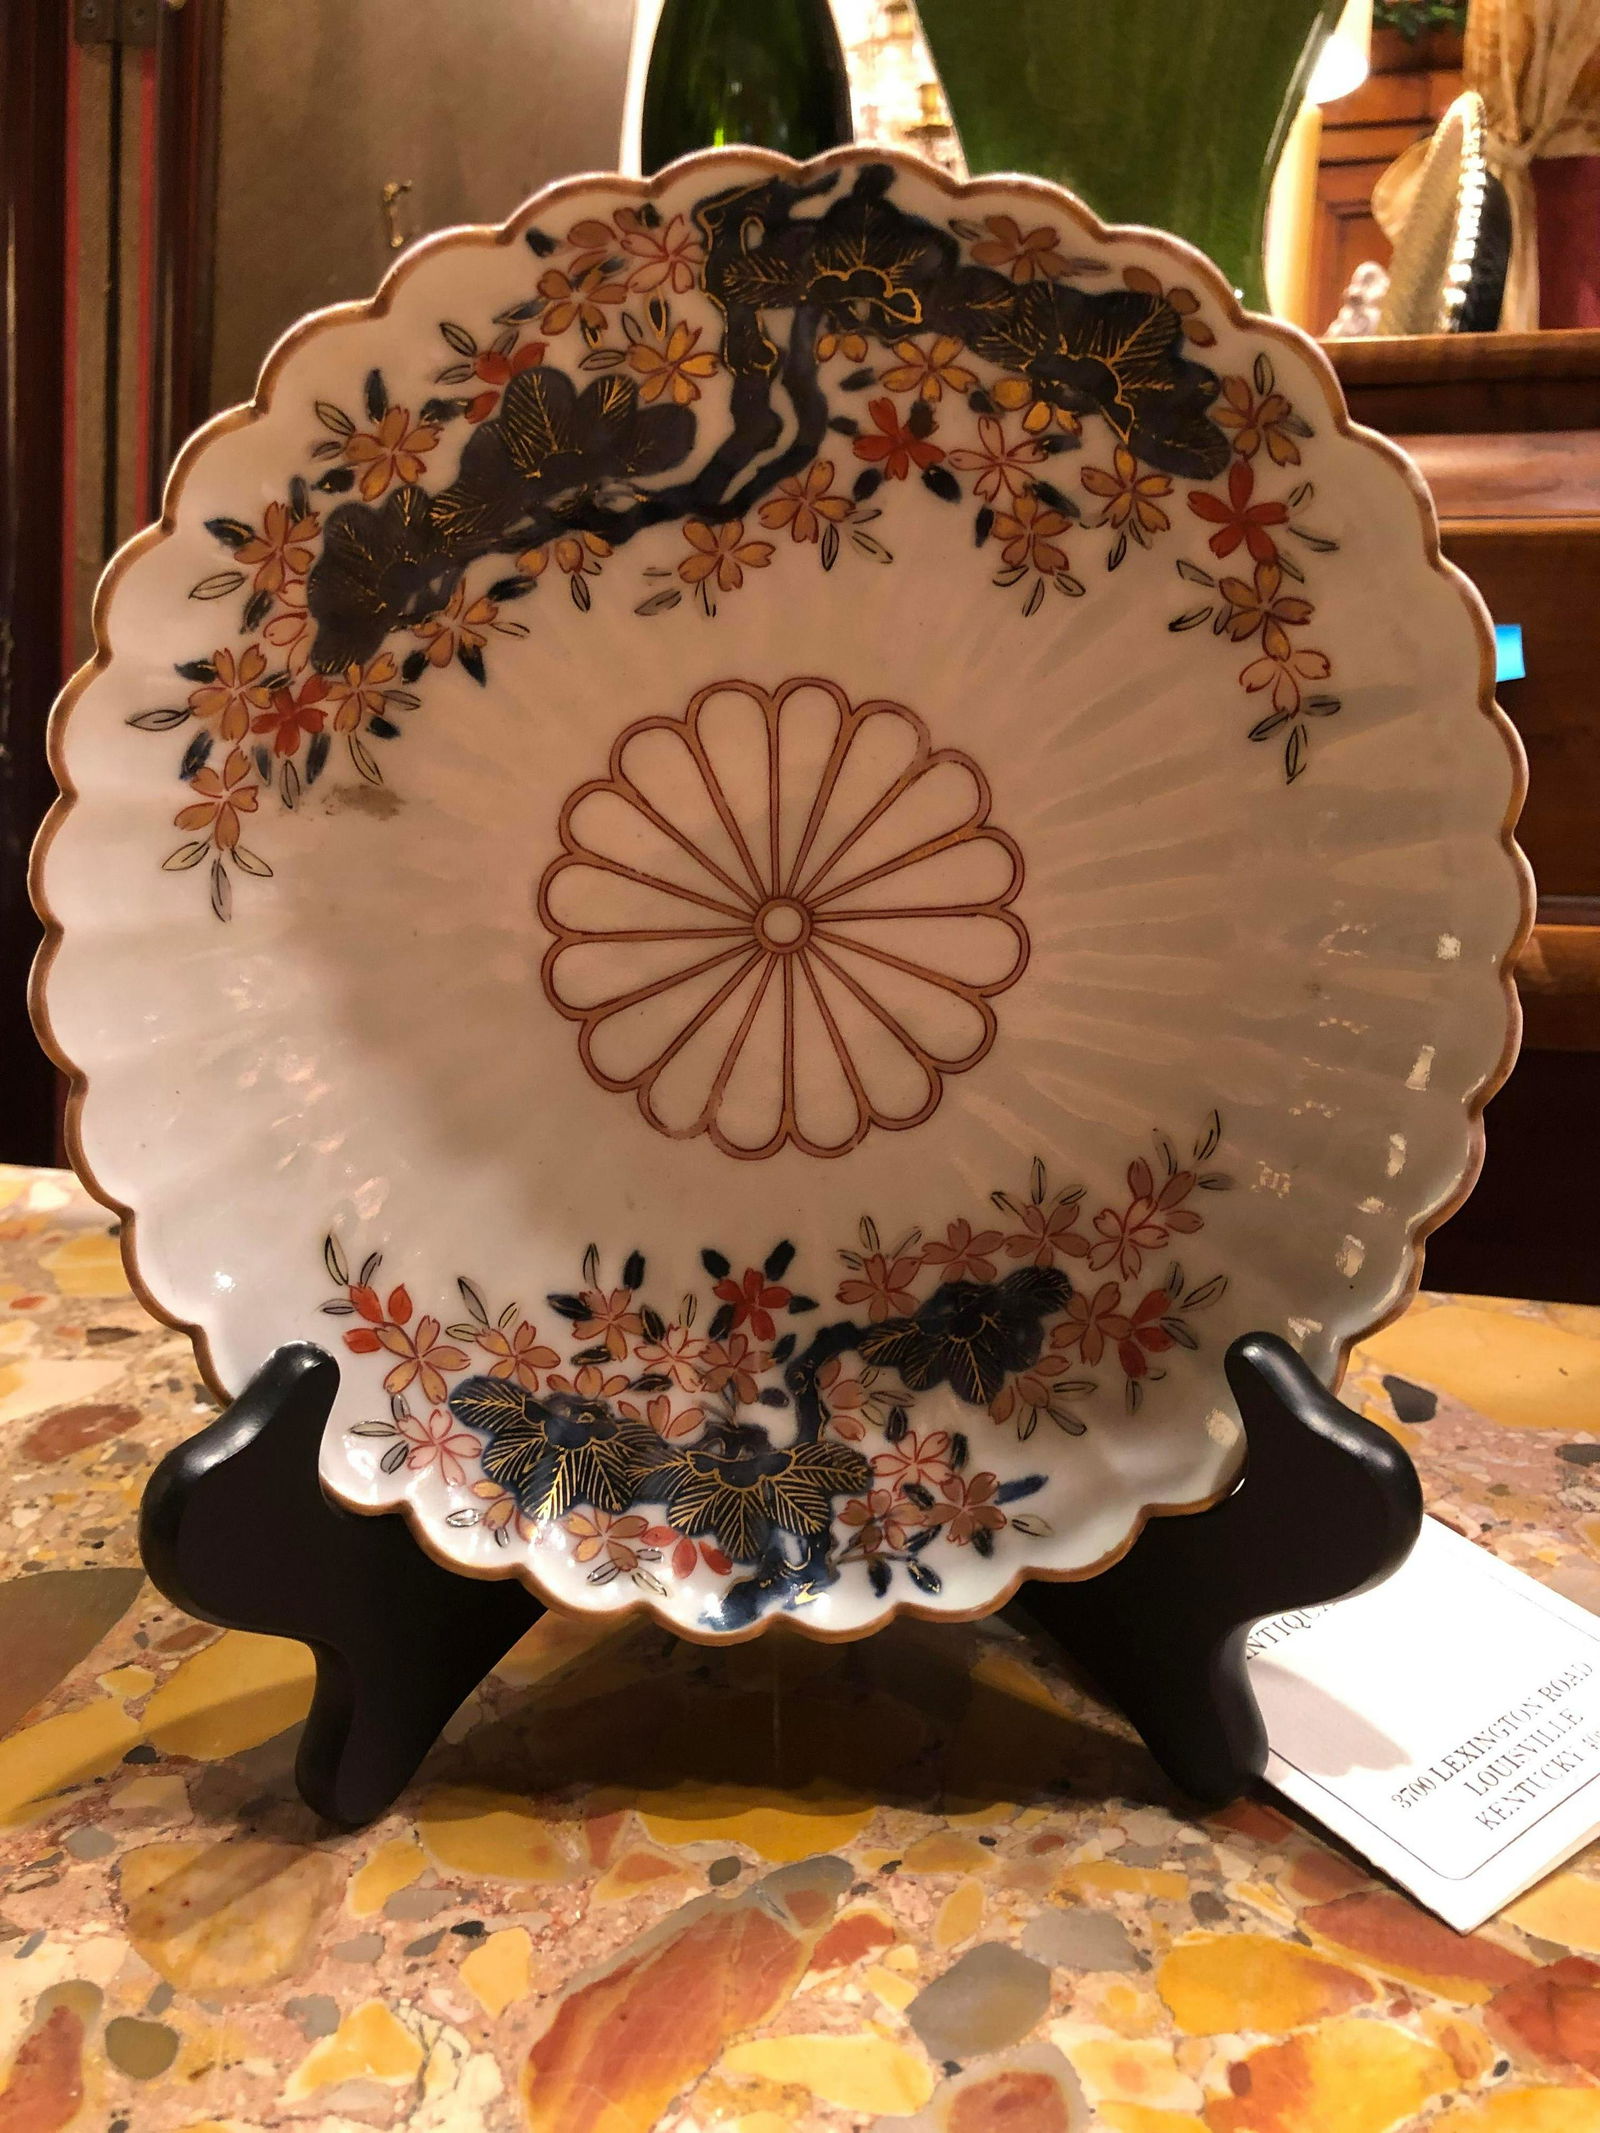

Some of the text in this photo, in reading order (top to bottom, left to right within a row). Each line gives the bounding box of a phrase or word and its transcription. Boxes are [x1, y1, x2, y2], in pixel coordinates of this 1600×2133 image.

[1391, 1776, 1437, 1808] 3700
[1428, 1697, 1543, 1781] LEXINGTON
[1538, 1663, 1593, 1702] ROAD
[1463, 1708, 1584, 1796] LOUISVILLE
[1475, 1745, 1584, 1830] KENTUCKY
